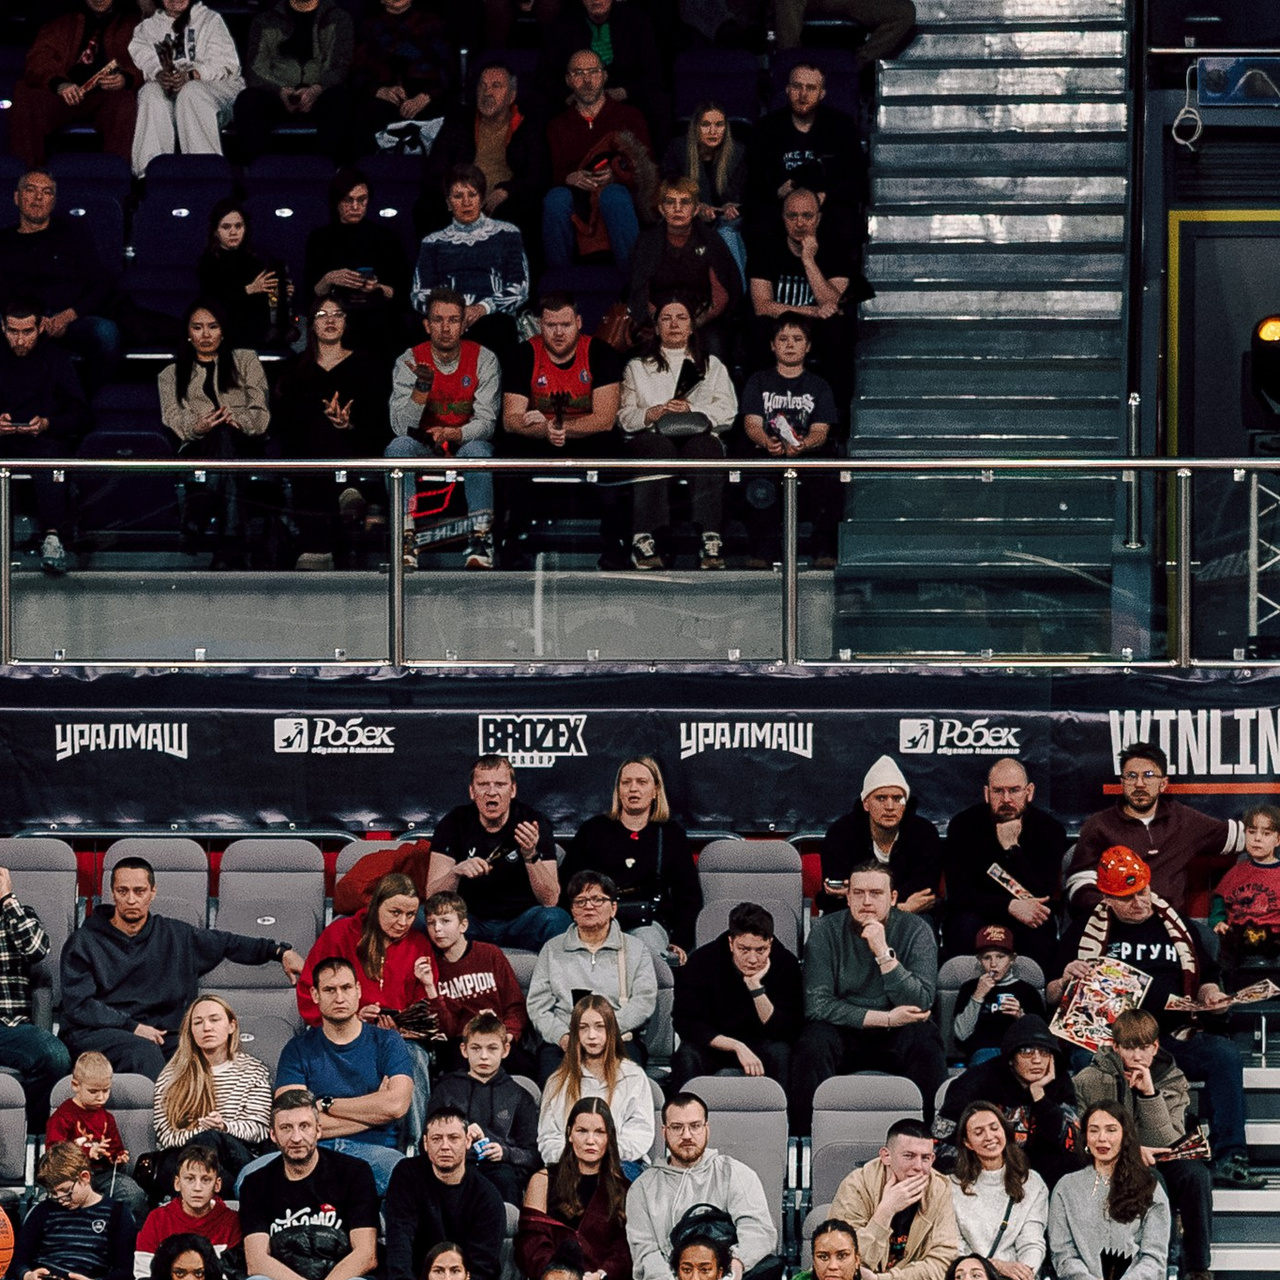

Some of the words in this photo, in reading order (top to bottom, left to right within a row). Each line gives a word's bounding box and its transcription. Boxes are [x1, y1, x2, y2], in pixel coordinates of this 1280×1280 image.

[55, 723, 189, 761] УРАЛМАШ
[313, 718, 396, 746] Робек
[480, 716, 586, 755] BROZEX
[680, 722, 813, 759] УРАЛМАШ
[938, 718, 1021, 746] Робек
